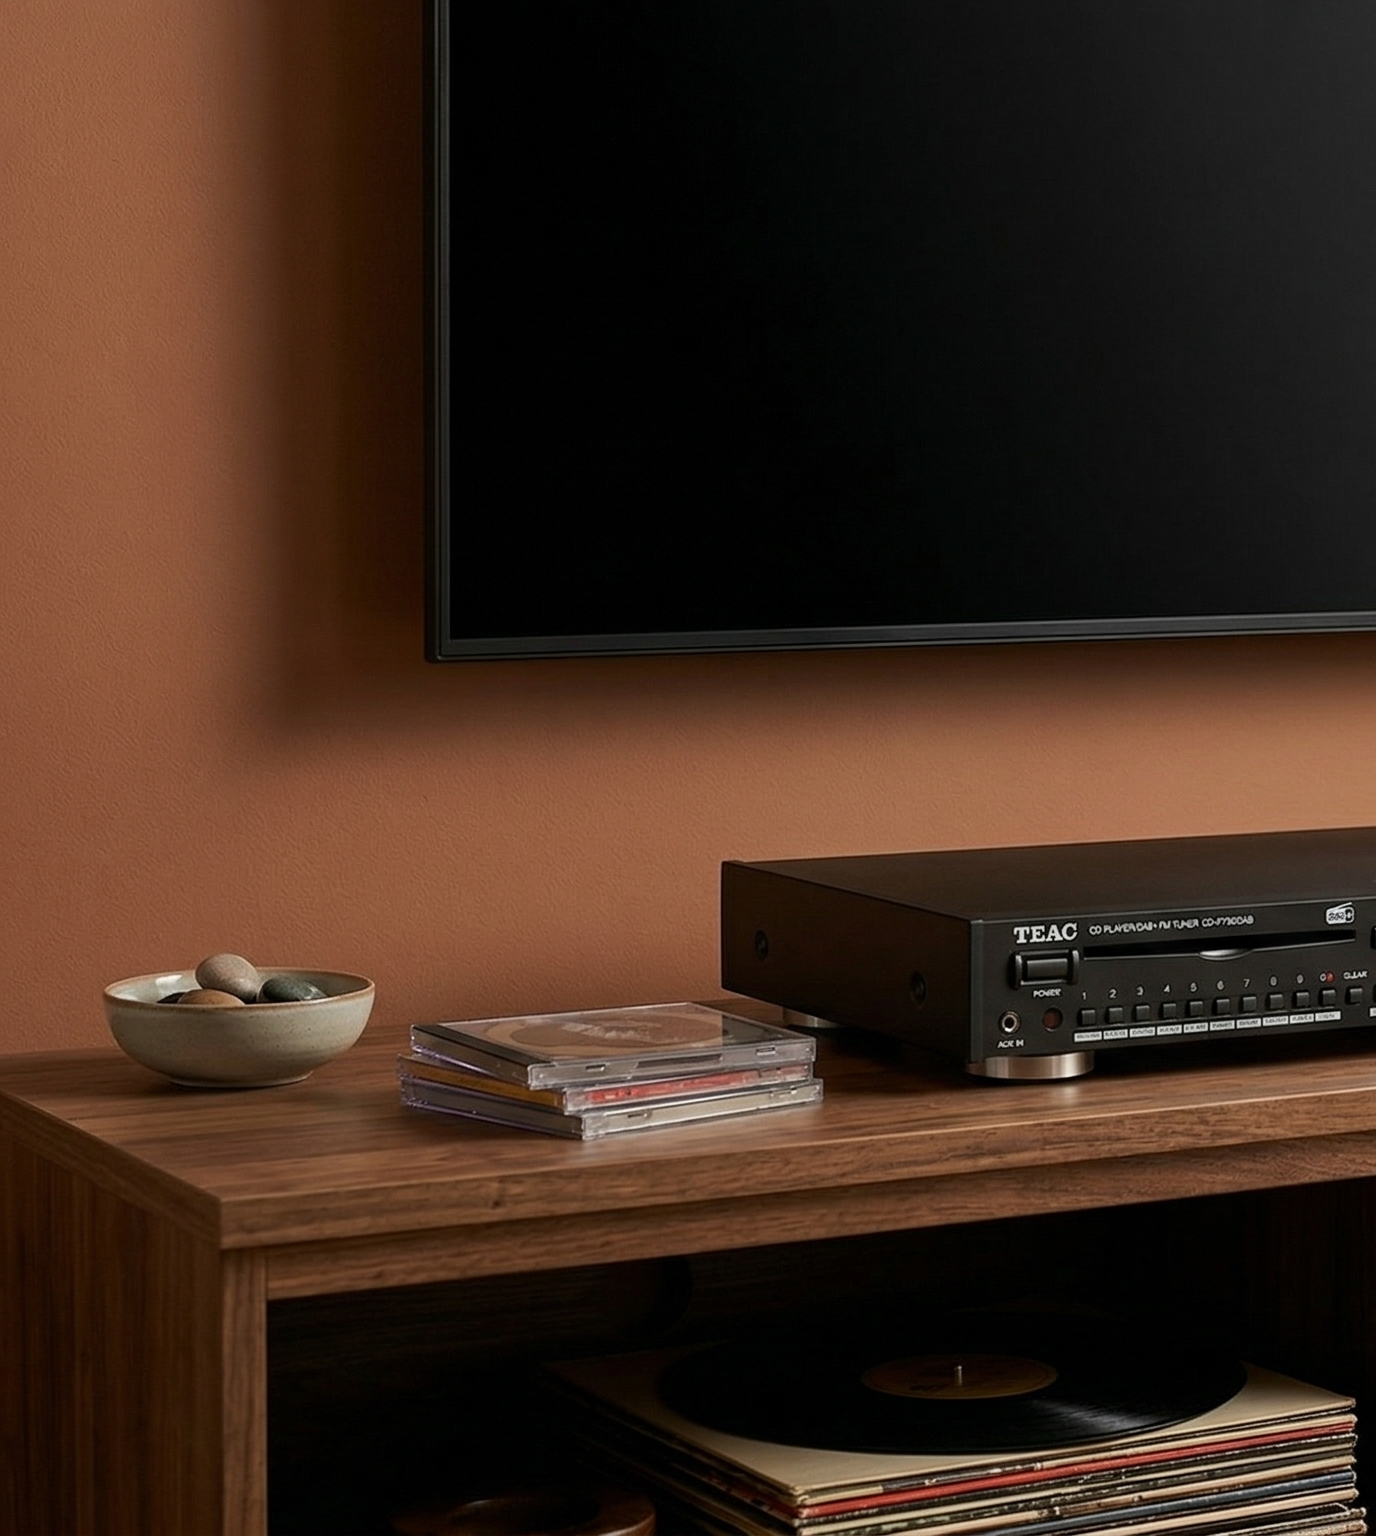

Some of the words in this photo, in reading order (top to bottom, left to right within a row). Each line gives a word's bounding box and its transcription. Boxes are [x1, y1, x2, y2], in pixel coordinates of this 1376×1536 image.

[1013, 922, 1078, 944] TEAC
[1109, 989, 1117, 998] 2
[1136, 986, 1144, 996] 3
[1163, 984, 1170, 993] 4
[1190, 982, 1197, 992] 5
[1243, 978, 1250, 988] 7
